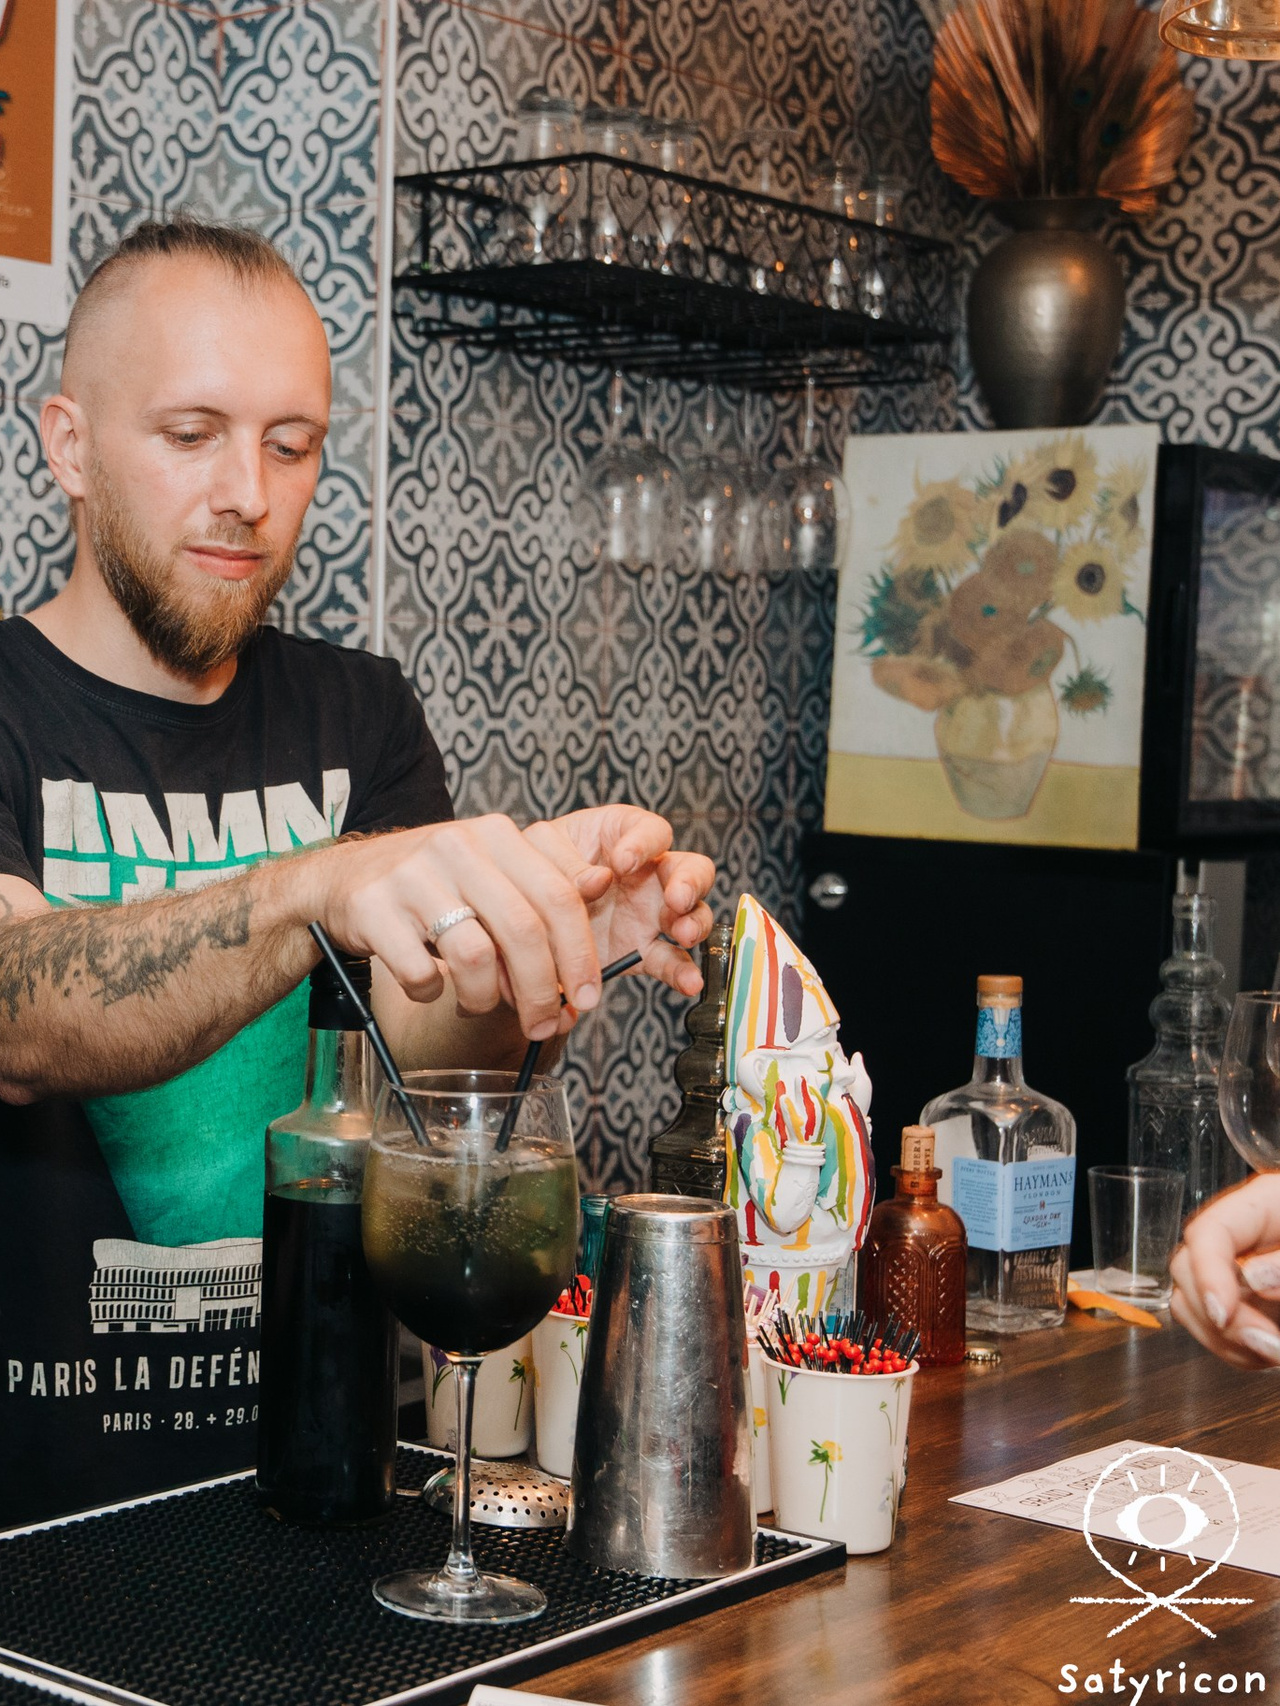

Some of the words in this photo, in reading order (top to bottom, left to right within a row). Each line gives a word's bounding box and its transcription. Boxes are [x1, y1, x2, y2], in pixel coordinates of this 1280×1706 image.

[8, 1359, 97, 1397] PARIS
[115, 1357, 151, 1391] LA
[103, 1411, 152, 1434] PARIS
[173, 1410, 200, 1431] 28.
